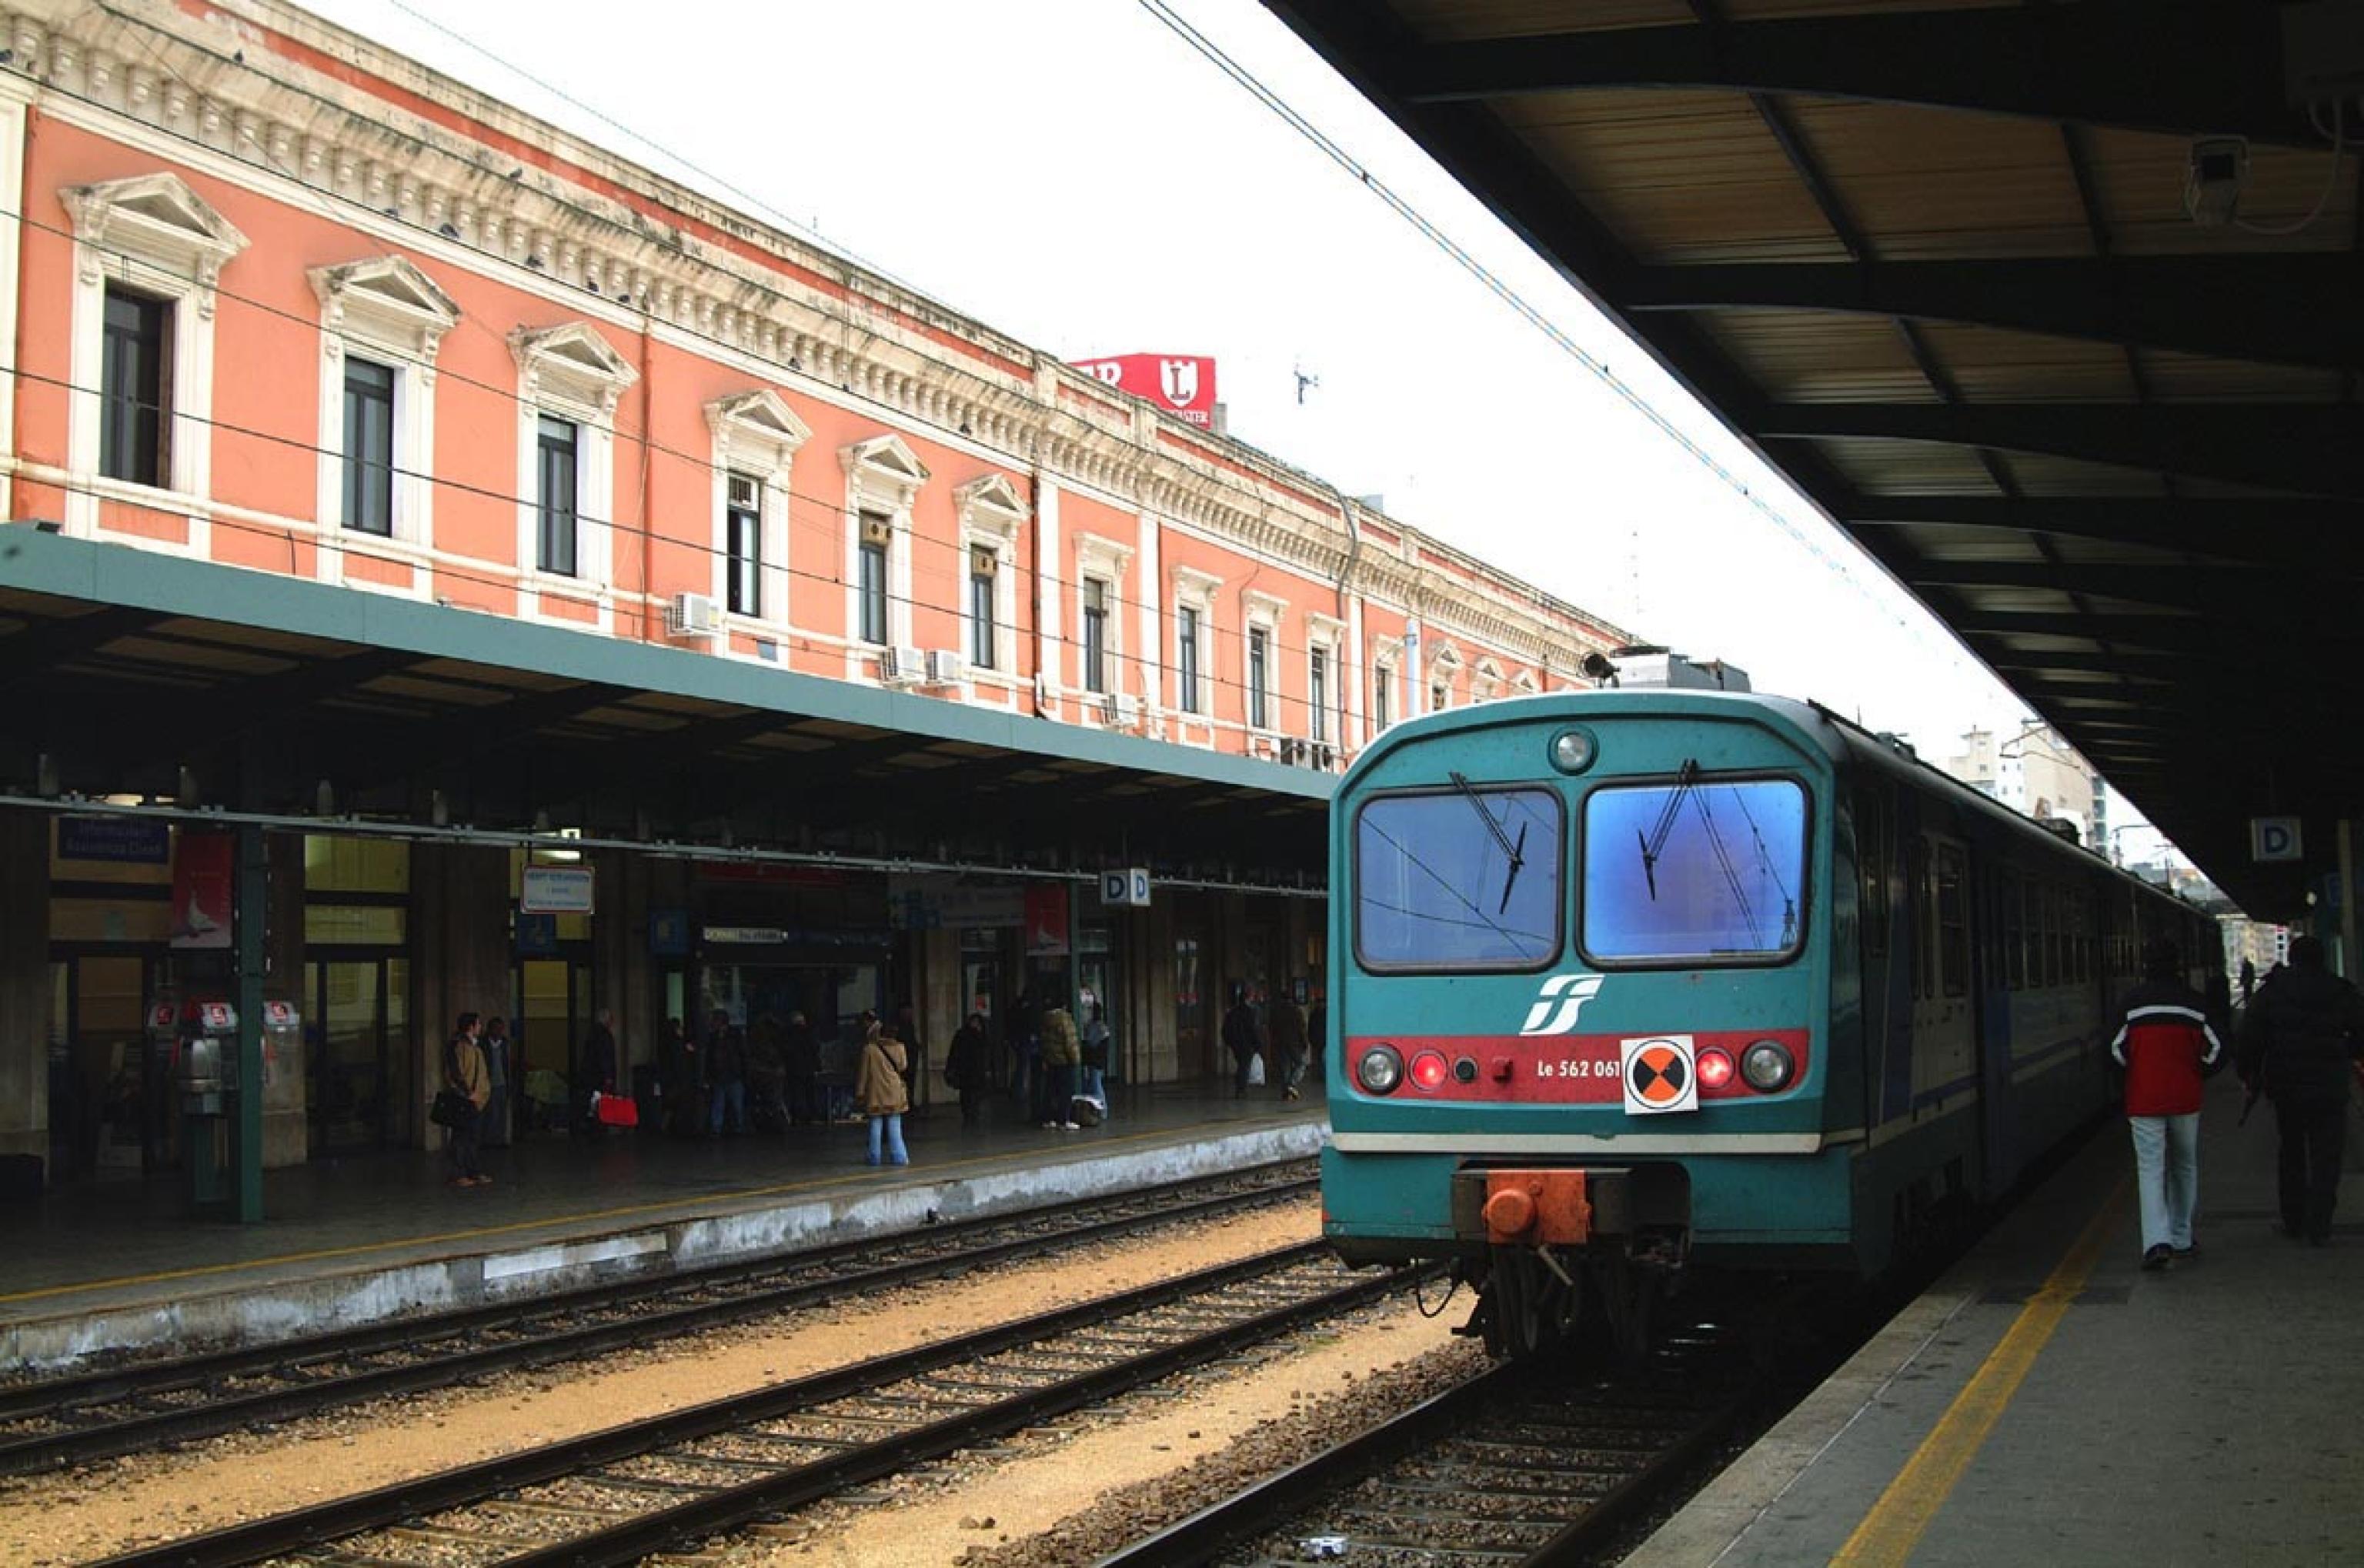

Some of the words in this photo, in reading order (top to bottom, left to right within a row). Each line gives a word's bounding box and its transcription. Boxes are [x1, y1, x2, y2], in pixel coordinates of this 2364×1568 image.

[2265, 827, 2288, 853] D
[1107, 876, 1124, 899] D
[1136, 874, 1145, 898] D
[1558, 1059, 1589, 1076] 562
[1594, 1060, 1620, 1076] 061
